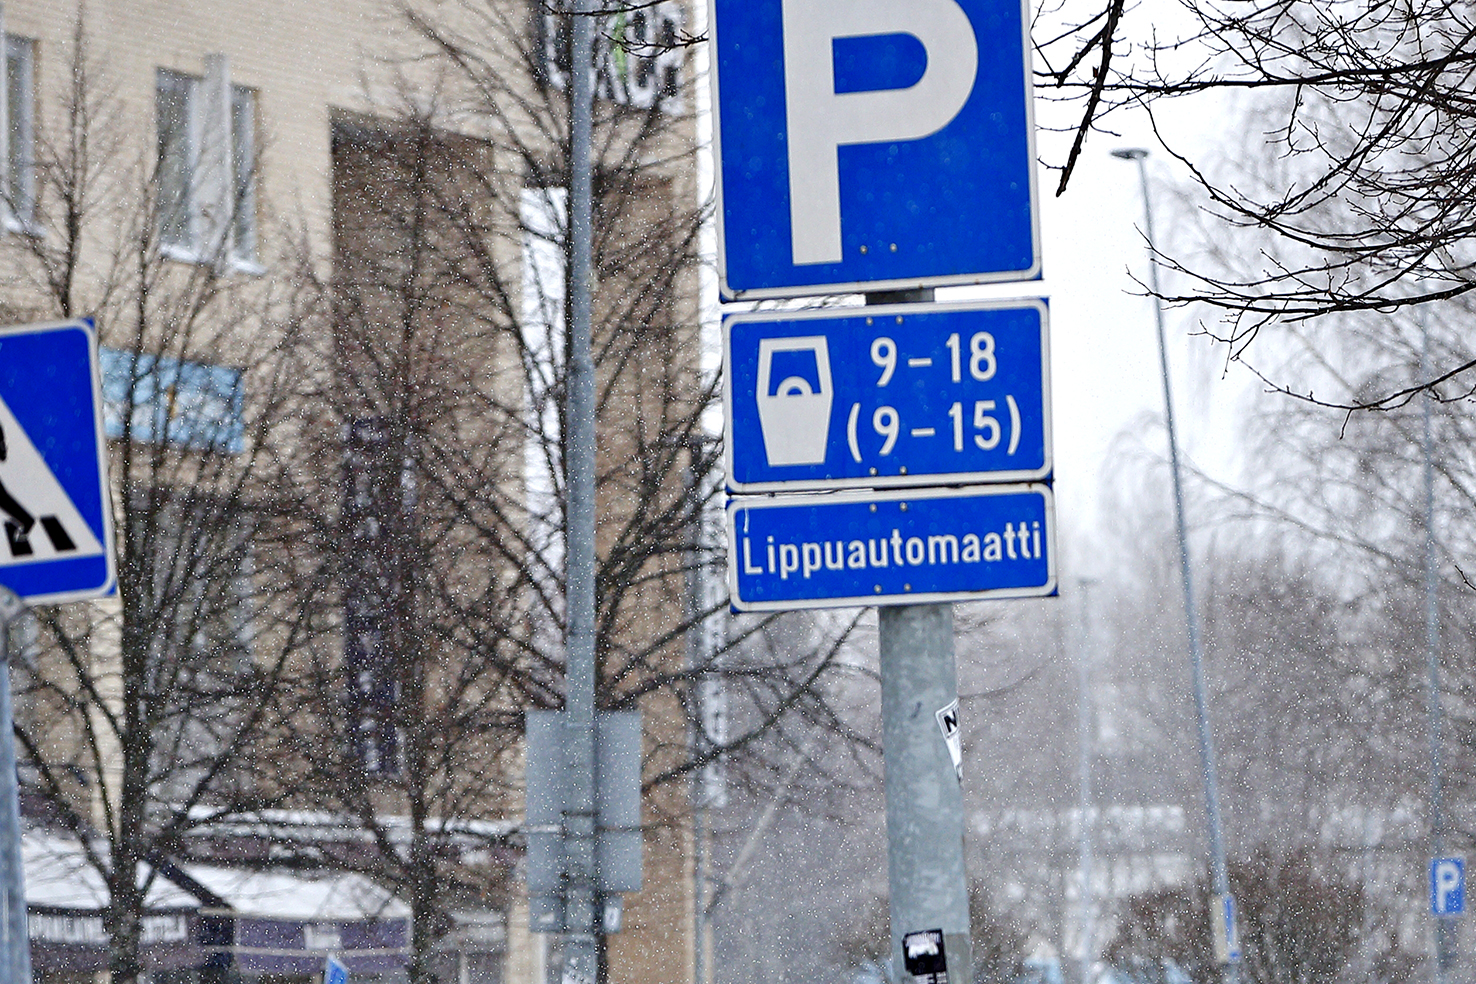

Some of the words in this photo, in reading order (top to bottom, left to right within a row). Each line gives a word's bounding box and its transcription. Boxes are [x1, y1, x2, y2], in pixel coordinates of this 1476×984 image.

[783, 0, 978, 266] P
[869, 331, 998, 387] 9-18
[743, 522, 1042, 580] Lippuautomaatti
[1435, 860, 1460, 912] P
